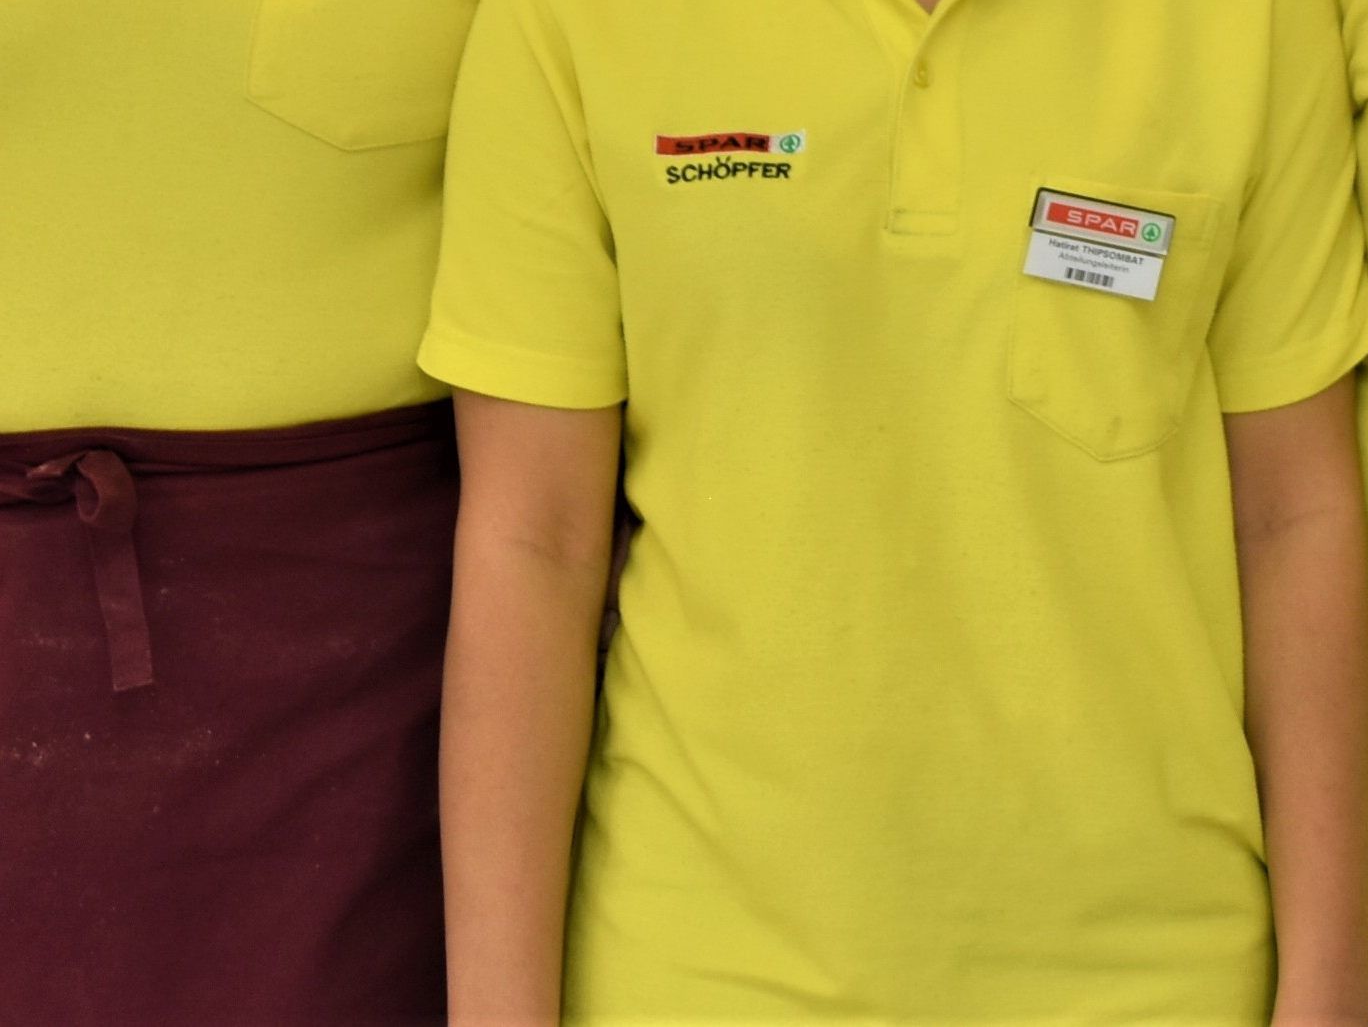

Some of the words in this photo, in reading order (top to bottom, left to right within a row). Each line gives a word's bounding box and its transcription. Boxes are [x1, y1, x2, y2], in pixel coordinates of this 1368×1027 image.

[674, 136, 767, 153] SPAR
[665, 155, 792, 184] SCHÖPFER
[1067, 209, 1137, 236] SPAR
